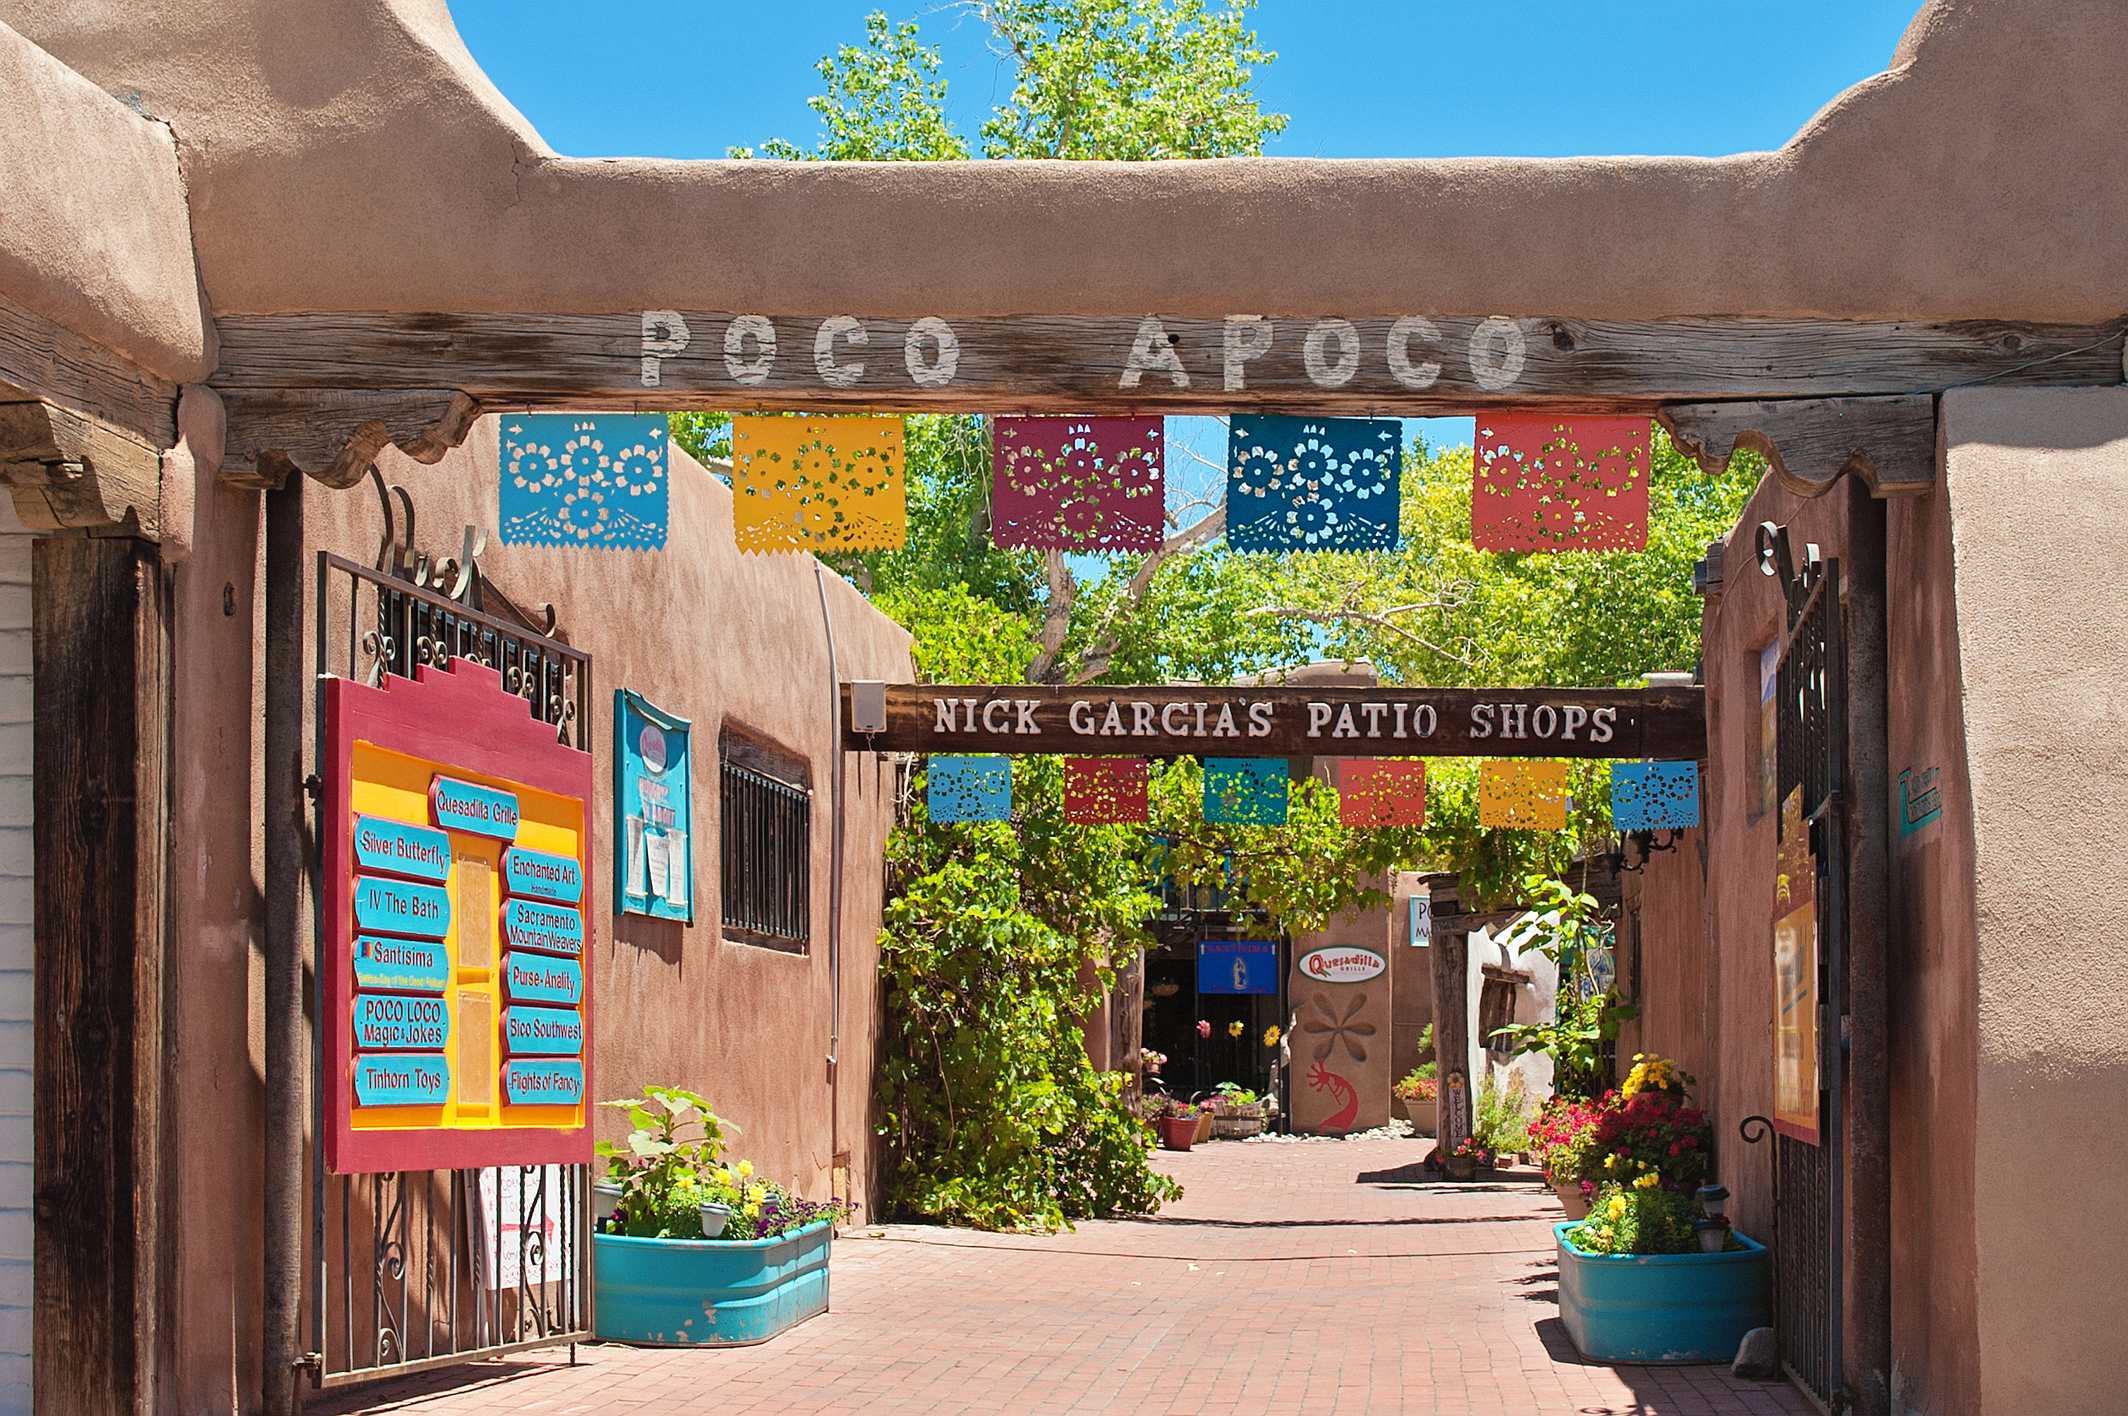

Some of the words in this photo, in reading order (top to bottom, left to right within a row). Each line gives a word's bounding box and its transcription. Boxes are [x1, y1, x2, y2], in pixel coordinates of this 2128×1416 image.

[640, 308, 960, 388] POCO
[933, 697, 1042, 735] NICK
[1068, 696, 1274, 738] GARCIA'S
[1306, 702, 1438, 739] PATIO
[1469, 703, 1618, 743] SHOPS
[437, 790, 489, 821] Quesadilla
[492, 802, 518, 826] Grille
[362, 830, 393, 856] Silver
[396, 836, 445, 875] Butterfly
[513, 855, 561, 883] Enchanted
[561, 864, 577, 886] Art
[369, 888, 382, 911] IV
[384, 891, 407, 915] The
[412, 895, 439, 920] Bath
[517, 903, 576, 931] Sacramento
[1308, 953, 1380, 978] Quesadilla
[366, 1000, 403, 1022] POCO
[407, 1001, 441, 1023] LOCO
[406, 1022, 442, 1044] Jokes
[533, 1017, 582, 1040] Southwest
[366, 1067, 410, 1089] Tinhorn
[414, 1067, 441, 1095] Toys
[511, 1071, 542, 1095] Flights
[542, 1071, 552, 1090] of
[553, 1071, 579, 1097] Fancy
